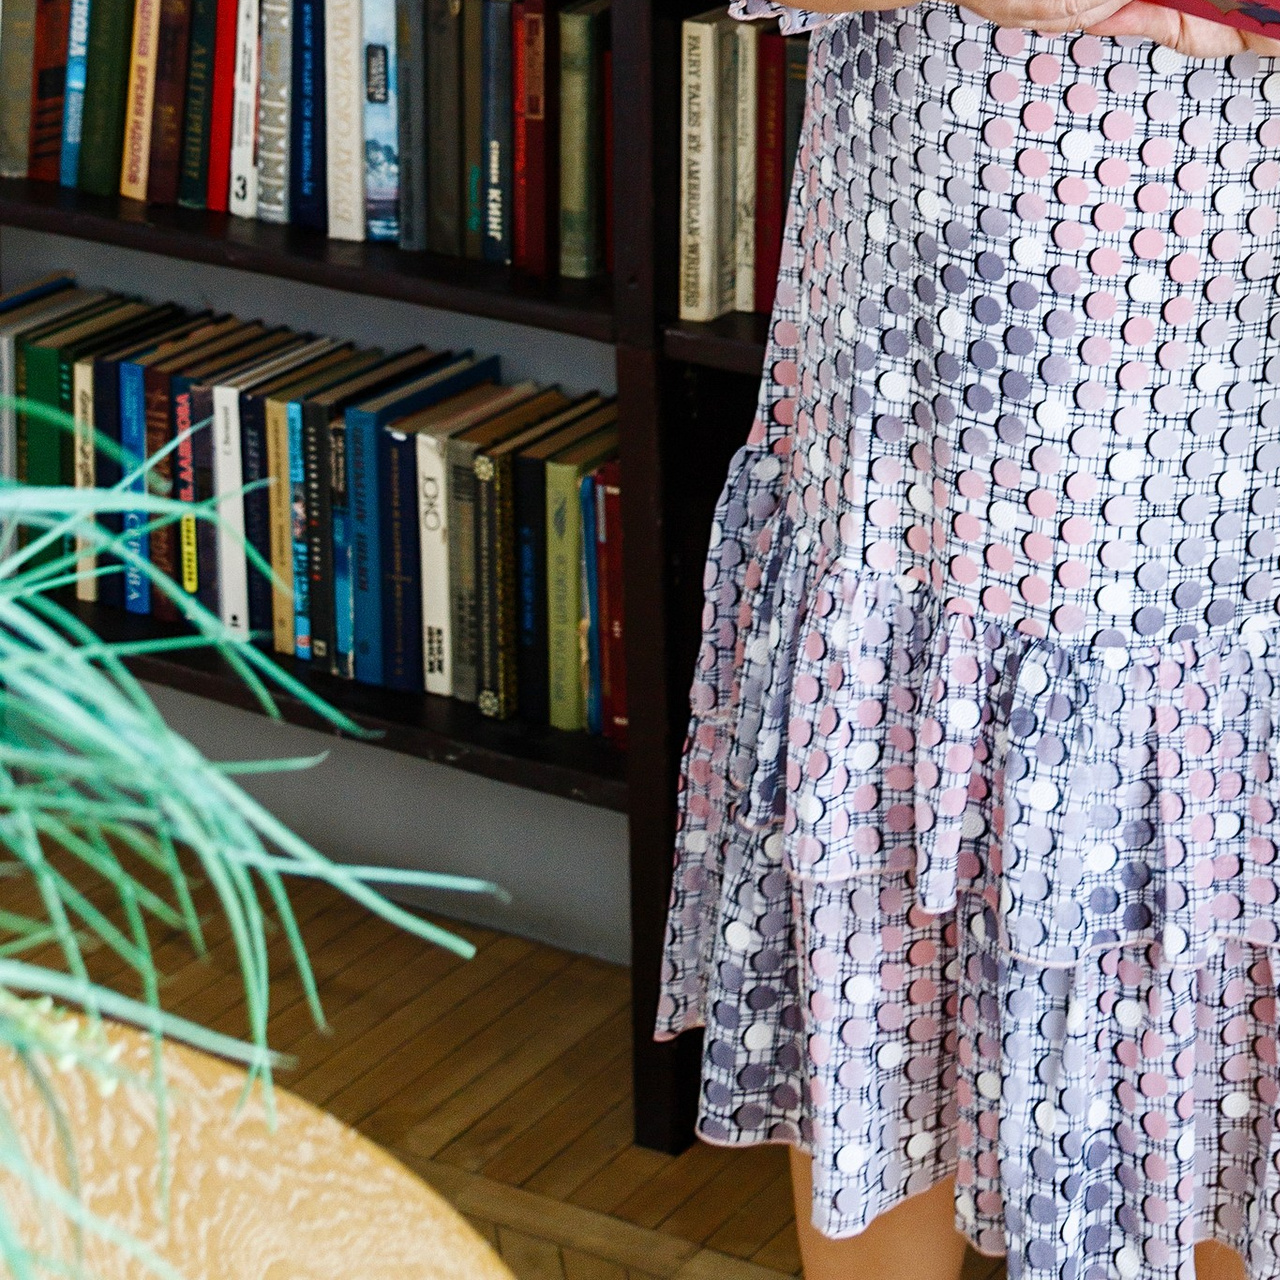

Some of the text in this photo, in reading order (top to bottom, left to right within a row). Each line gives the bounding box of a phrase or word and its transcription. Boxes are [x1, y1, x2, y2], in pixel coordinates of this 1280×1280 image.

[687, 35, 701, 78] FAIRY
[687, 79, 700, 128] TALES
[687, 133, 700, 154] BY
[487, 188, 504, 241] КИНГ
[686, 158, 700, 237] AMERICAN
